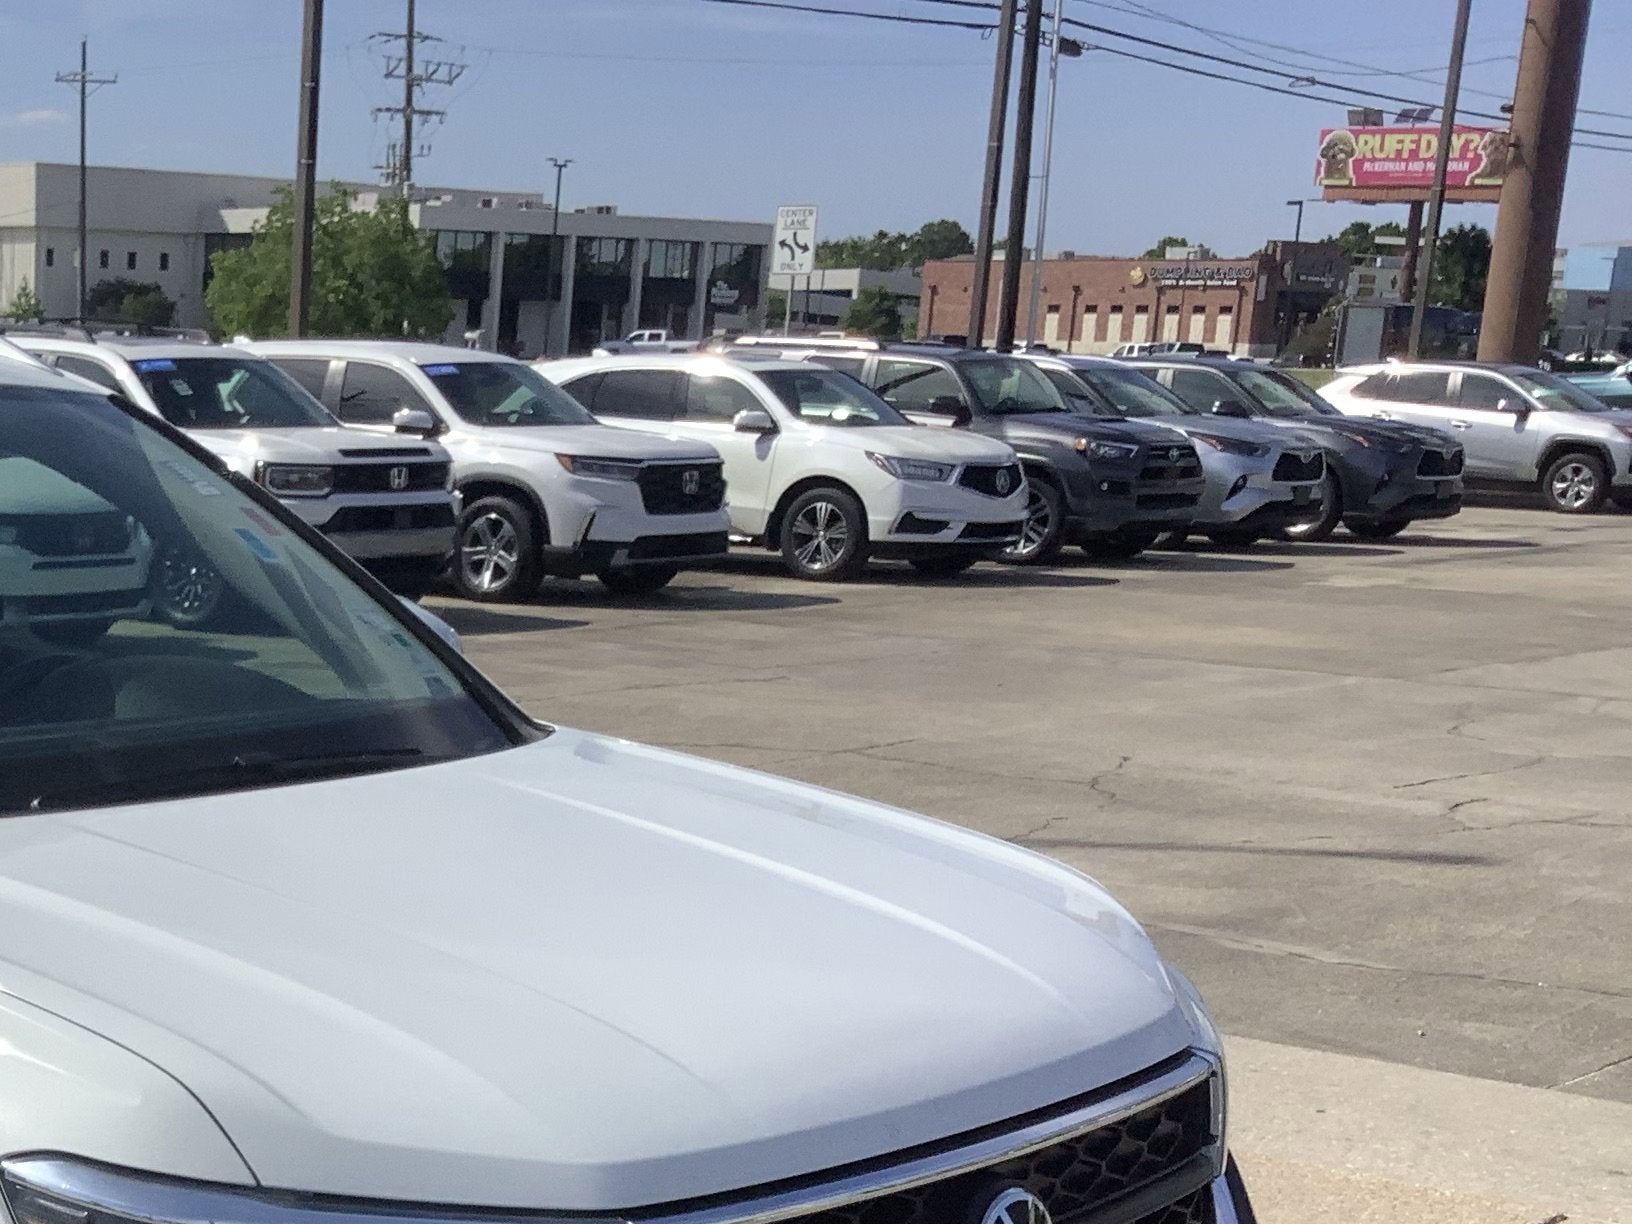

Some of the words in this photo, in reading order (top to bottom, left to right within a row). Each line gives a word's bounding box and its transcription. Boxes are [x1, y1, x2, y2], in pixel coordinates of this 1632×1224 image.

[1358, 134, 1416, 158] RUFF
[1419, 133, 1480, 158] DY?
[780, 208, 814, 218] CENTER
[784, 219, 807, 227] LANE
[780, 263, 803, 271] ONLY
